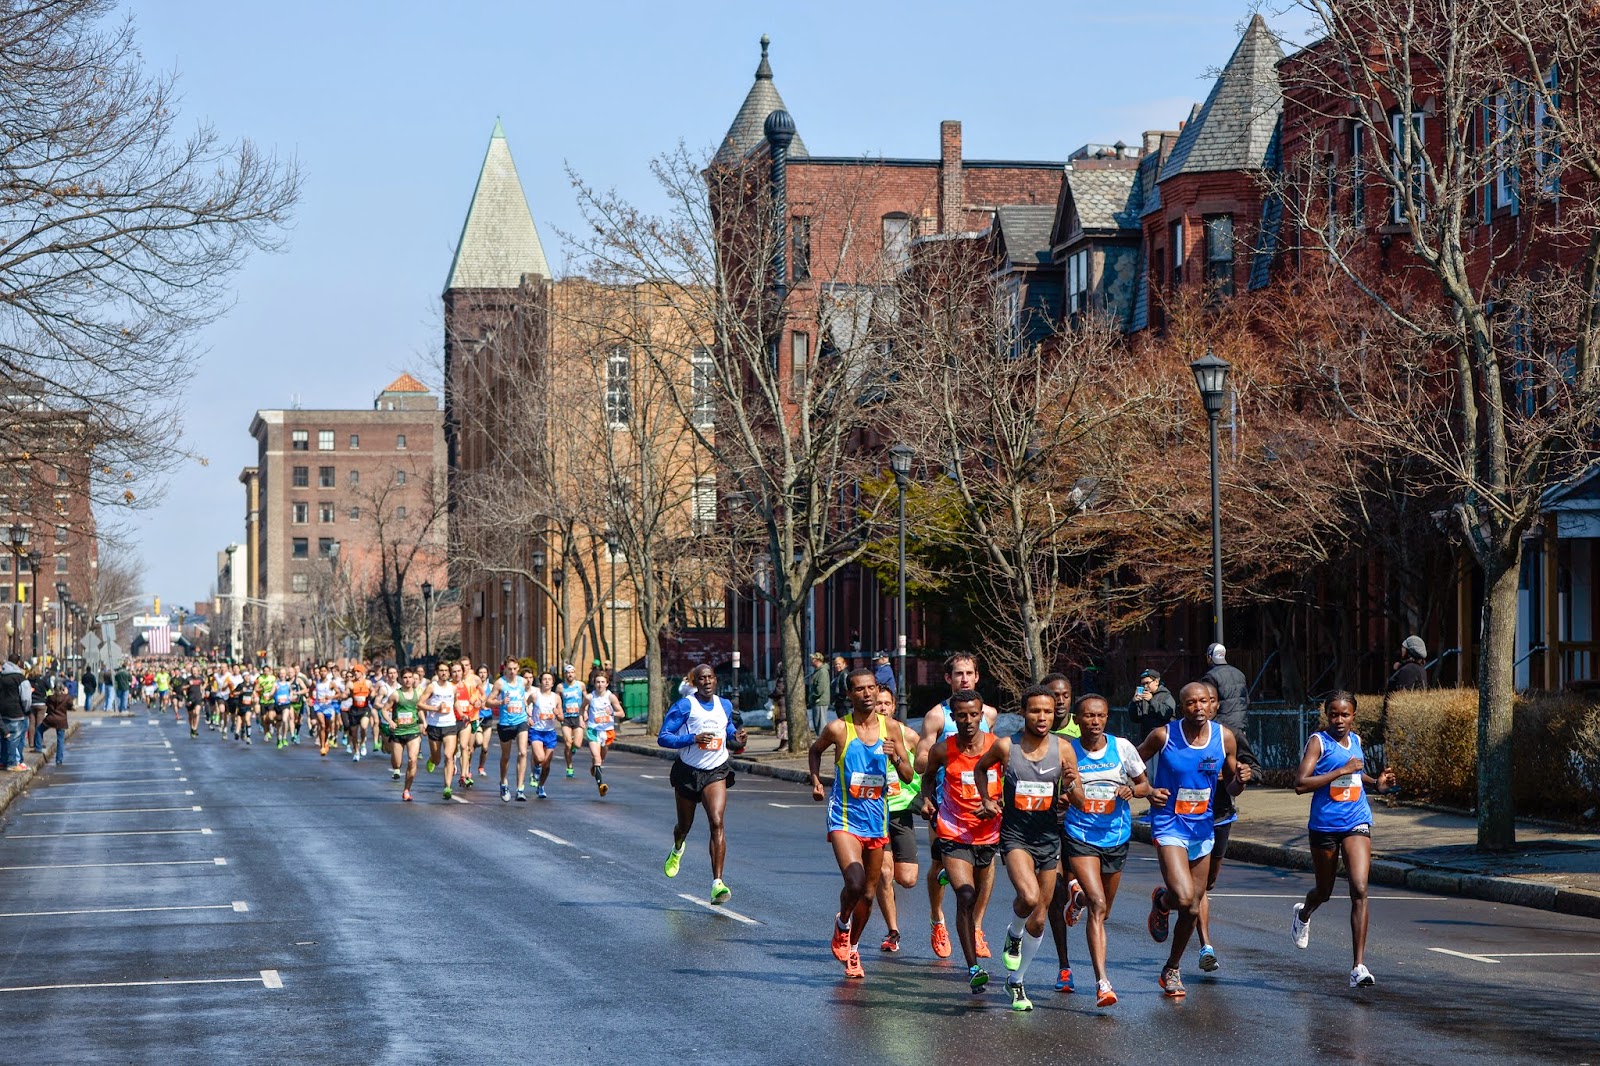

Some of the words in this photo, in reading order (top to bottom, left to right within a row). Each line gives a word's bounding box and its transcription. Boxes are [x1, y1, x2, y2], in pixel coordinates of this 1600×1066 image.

[1078, 762, 1116, 771] BROOKS
[859, 787, 875, 798] 16
[1343, 788, 1351, 800] 9
[1026, 797, 1044, 810] 17
[1089, 801, 1106, 813] 13
[1190, 802, 1199, 813] 7
